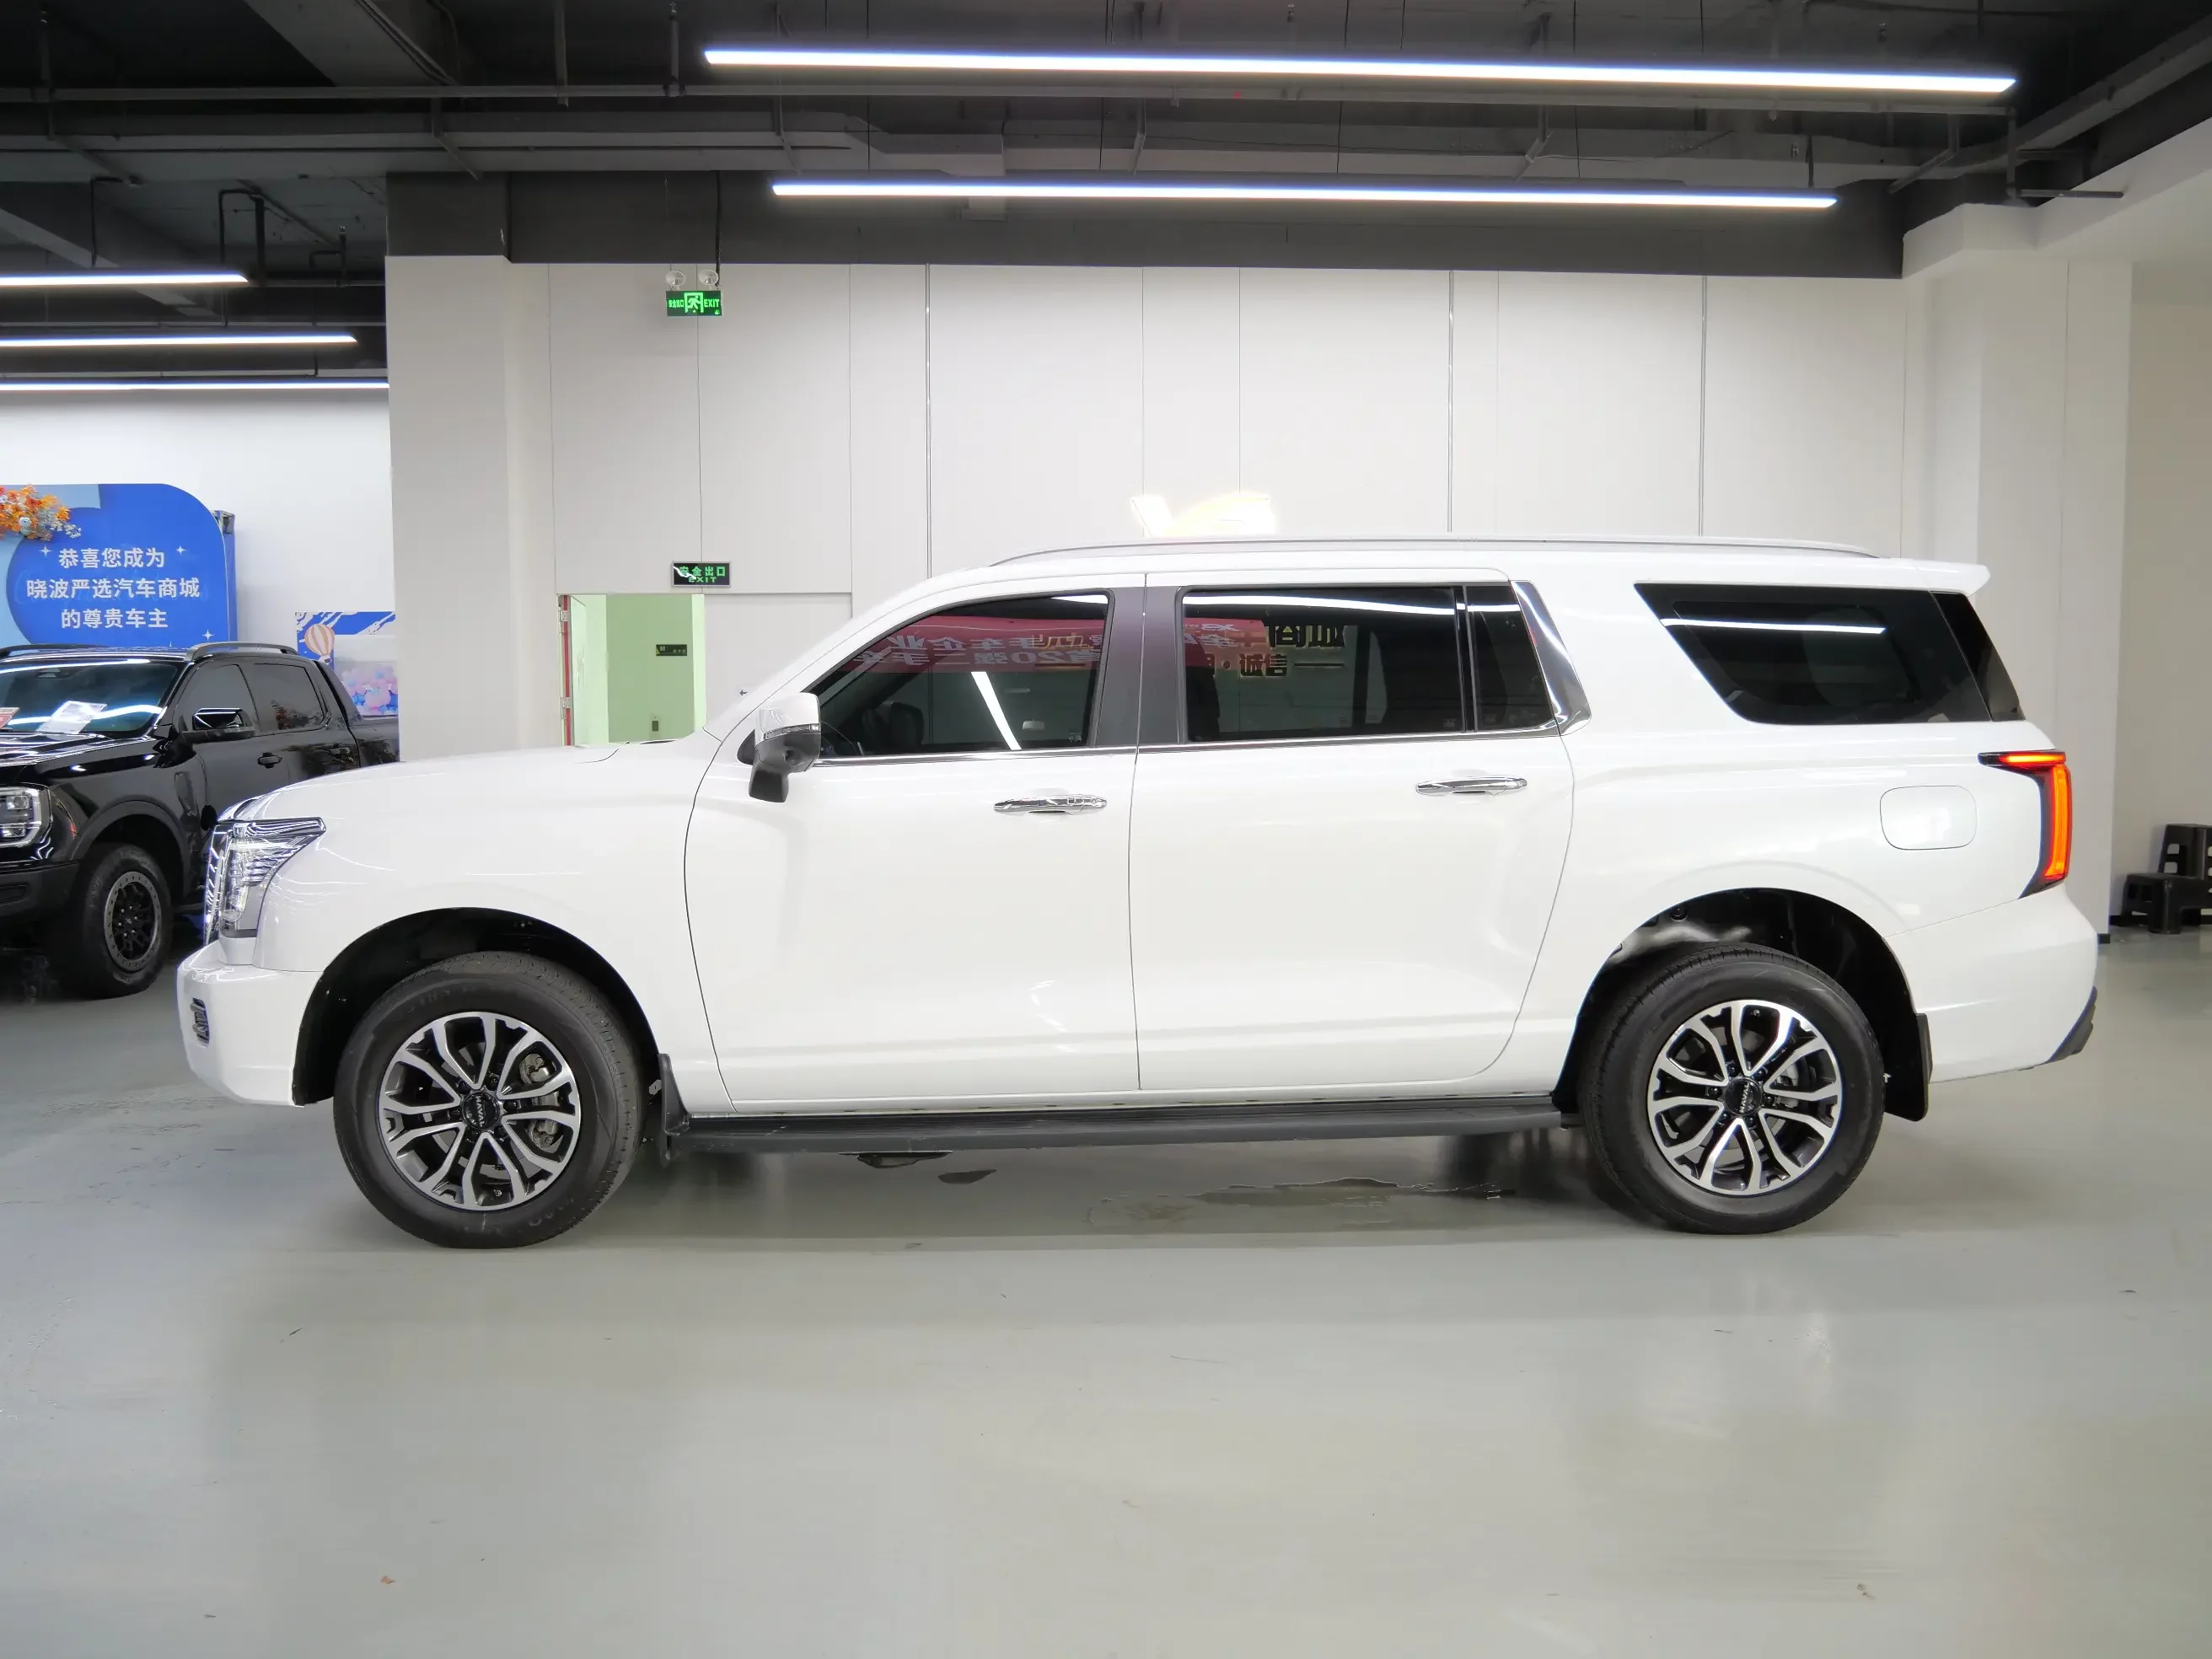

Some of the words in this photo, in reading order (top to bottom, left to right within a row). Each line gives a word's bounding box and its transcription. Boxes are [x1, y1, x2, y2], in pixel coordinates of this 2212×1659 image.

[703, 298, 720, 308] EXIT
[58, 547, 165, 569] 恭喜您成为
[679, 566, 726, 577] 安全出口
[26, 577, 201, 599] 晓波严选汽车商城
[61, 608, 169, 629] 的尊贵车主
[475, 1095, 486, 1128] HAVAL
